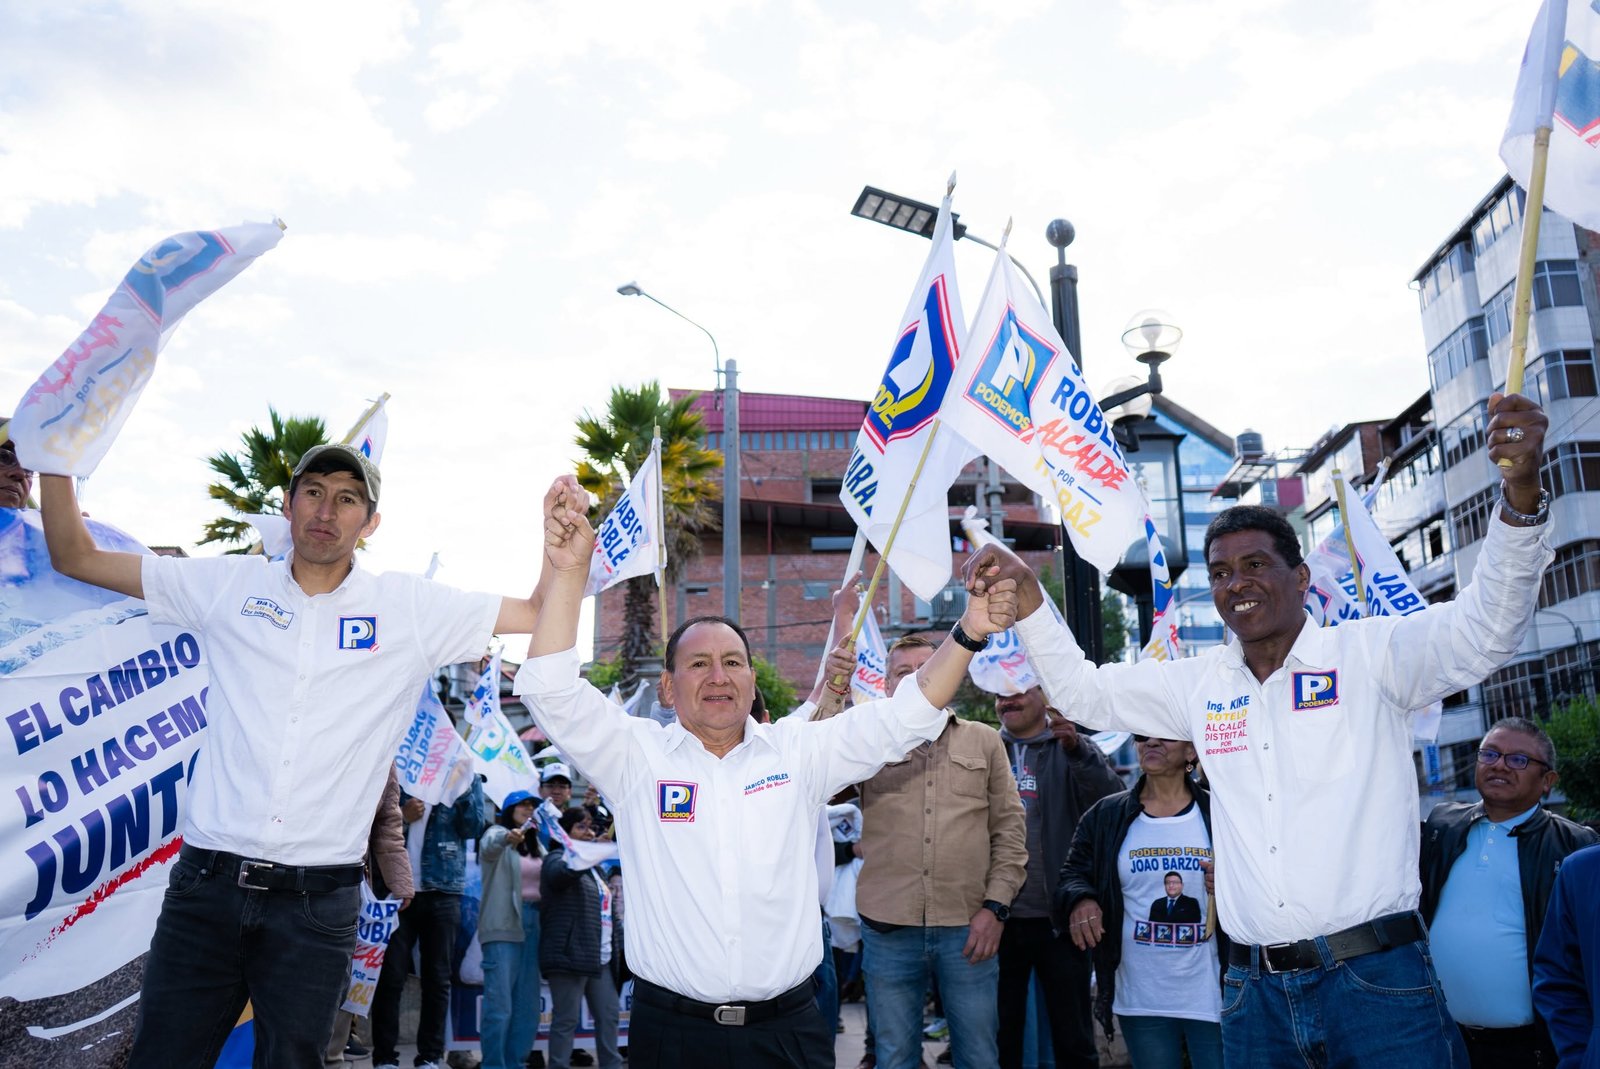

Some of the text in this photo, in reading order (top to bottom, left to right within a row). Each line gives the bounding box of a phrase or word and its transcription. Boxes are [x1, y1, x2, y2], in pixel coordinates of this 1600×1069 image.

[974, 382, 1031, 430] PODEMOS
[1050, 376, 1130, 473] ROBLE
[1037, 418, 1129, 491] ALCALDE
[1057, 469, 1075, 487] POR
[5, 632, 200, 756] EL CAMBIO
[1207, 695, 1250, 713] Ing. KIKE
[1298, 698, 1334, 709] PODEMOS
[1206, 708, 1248, 721] SOTELO
[1205, 719, 1247, 732] ALCALDE
[1205, 729, 1248, 741] DISTRITAL
[744, 773, 789, 790] JABICO ROBLES
[15, 770, 69, 828] LO
[1129, 847, 1182, 859] PODEMOS
[1130, 857, 1159, 874] JOAO
